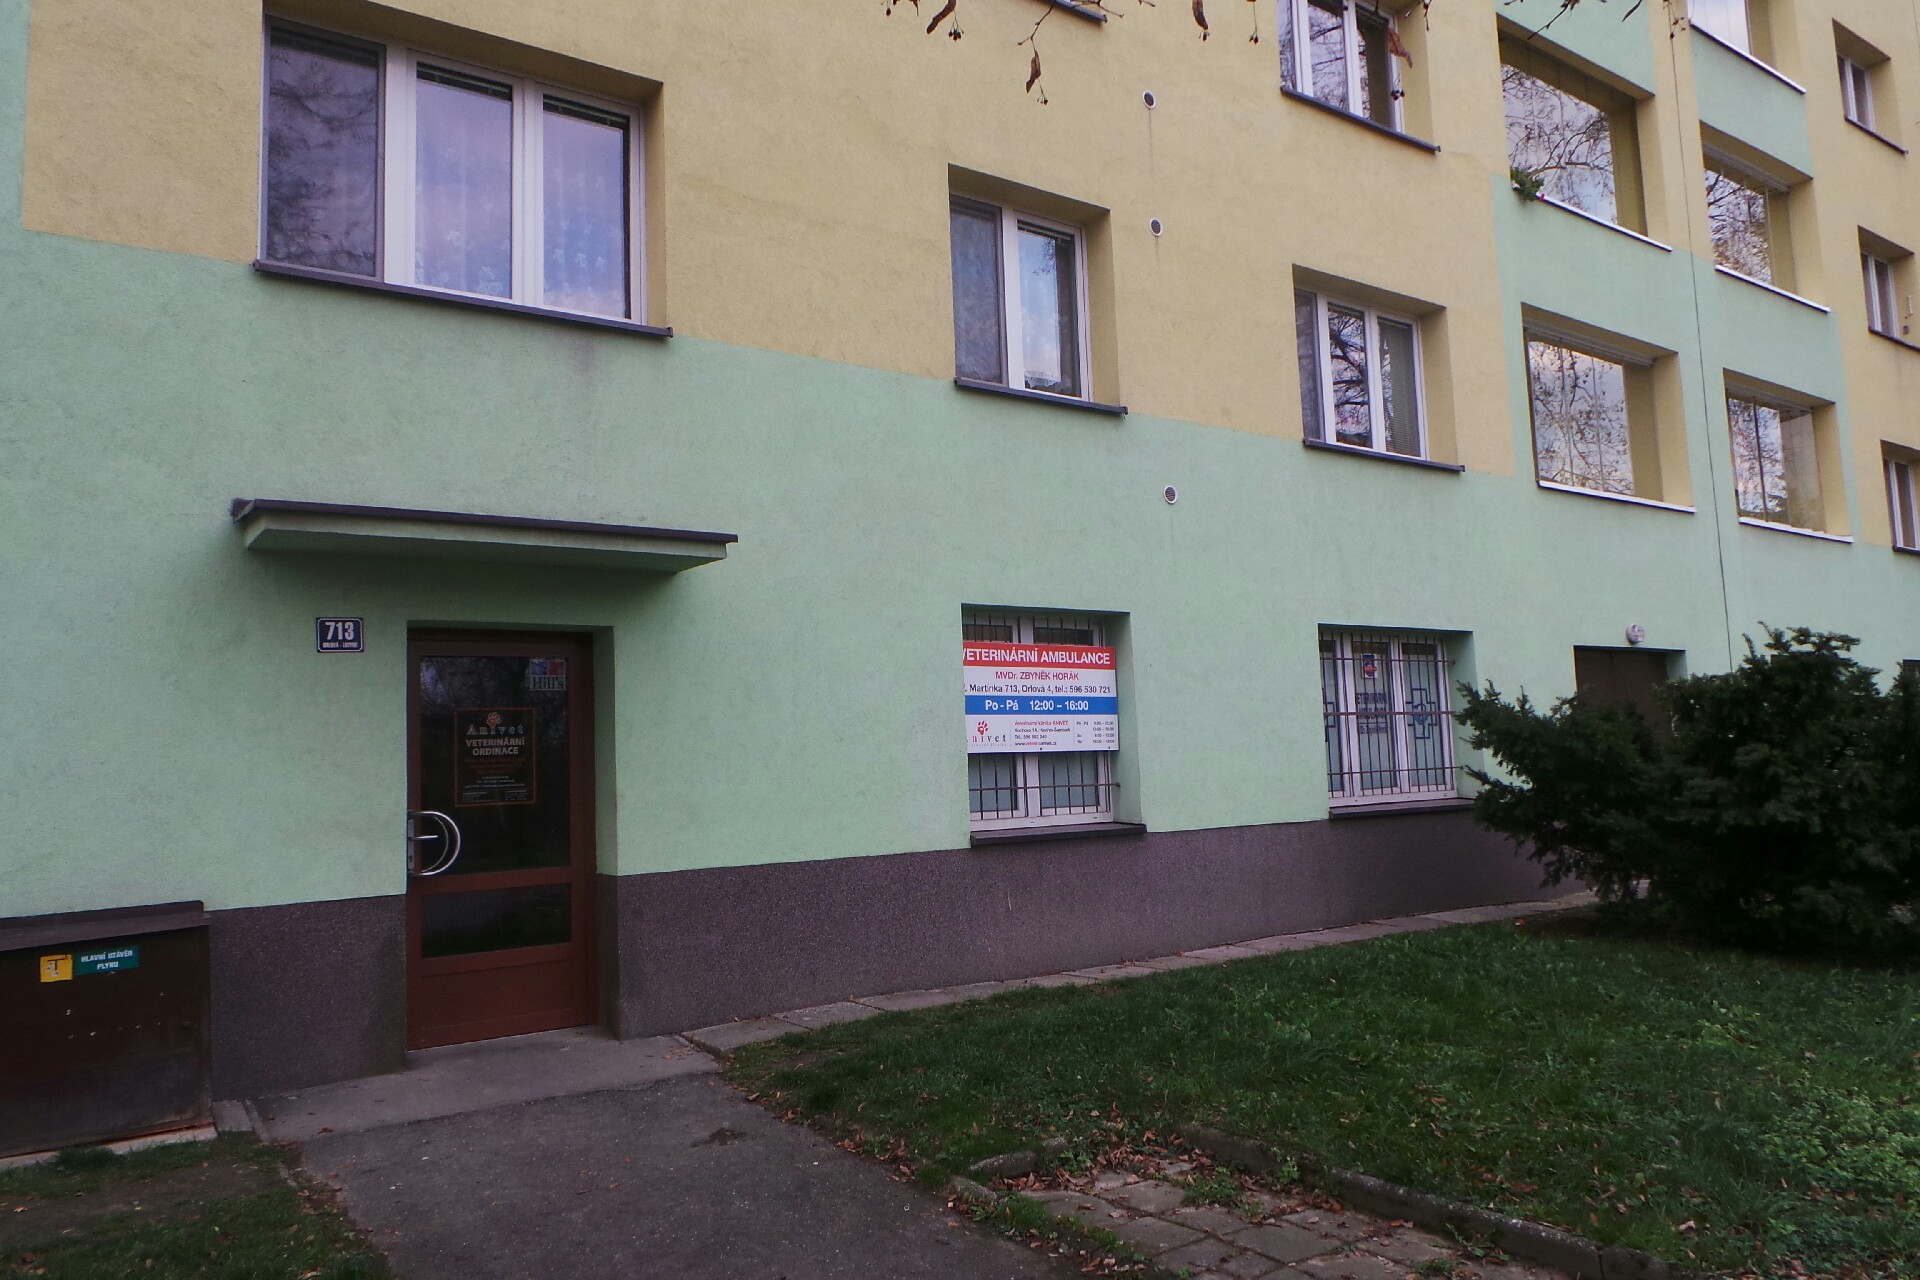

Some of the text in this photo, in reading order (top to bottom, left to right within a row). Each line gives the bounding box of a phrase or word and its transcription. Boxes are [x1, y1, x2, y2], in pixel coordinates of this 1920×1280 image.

[325, 621, 354, 640] 713
[1041, 652, 1111, 665] AMBULANCE
[995, 670, 1079, 681] MVDr. ZBYNĚK HORÁK
[1005, 684, 1020, 694] 713,
[1021, 684, 1045, 693] Orlová
[1047, 685, 1054, 694] 4,
[1069, 685, 1083, 694] 596
[1084, 686, 1097, 694] 530
[1099, 686, 1111, 694] 721
[985, 699, 999, 711] Po
[1006, 699, 1019, 711] Pá
[1029, 700, 1054, 711] 12:00
[1064, 700, 1089, 711] 16:00
[465, 737, 525, 747] VETERINÁRNÍ
[472, 746, 519, 756] ORDINACE
[81, 949, 133, 963] HLAVNÍ UZÁVĚR
[96, 961, 119, 970] PLYNU
